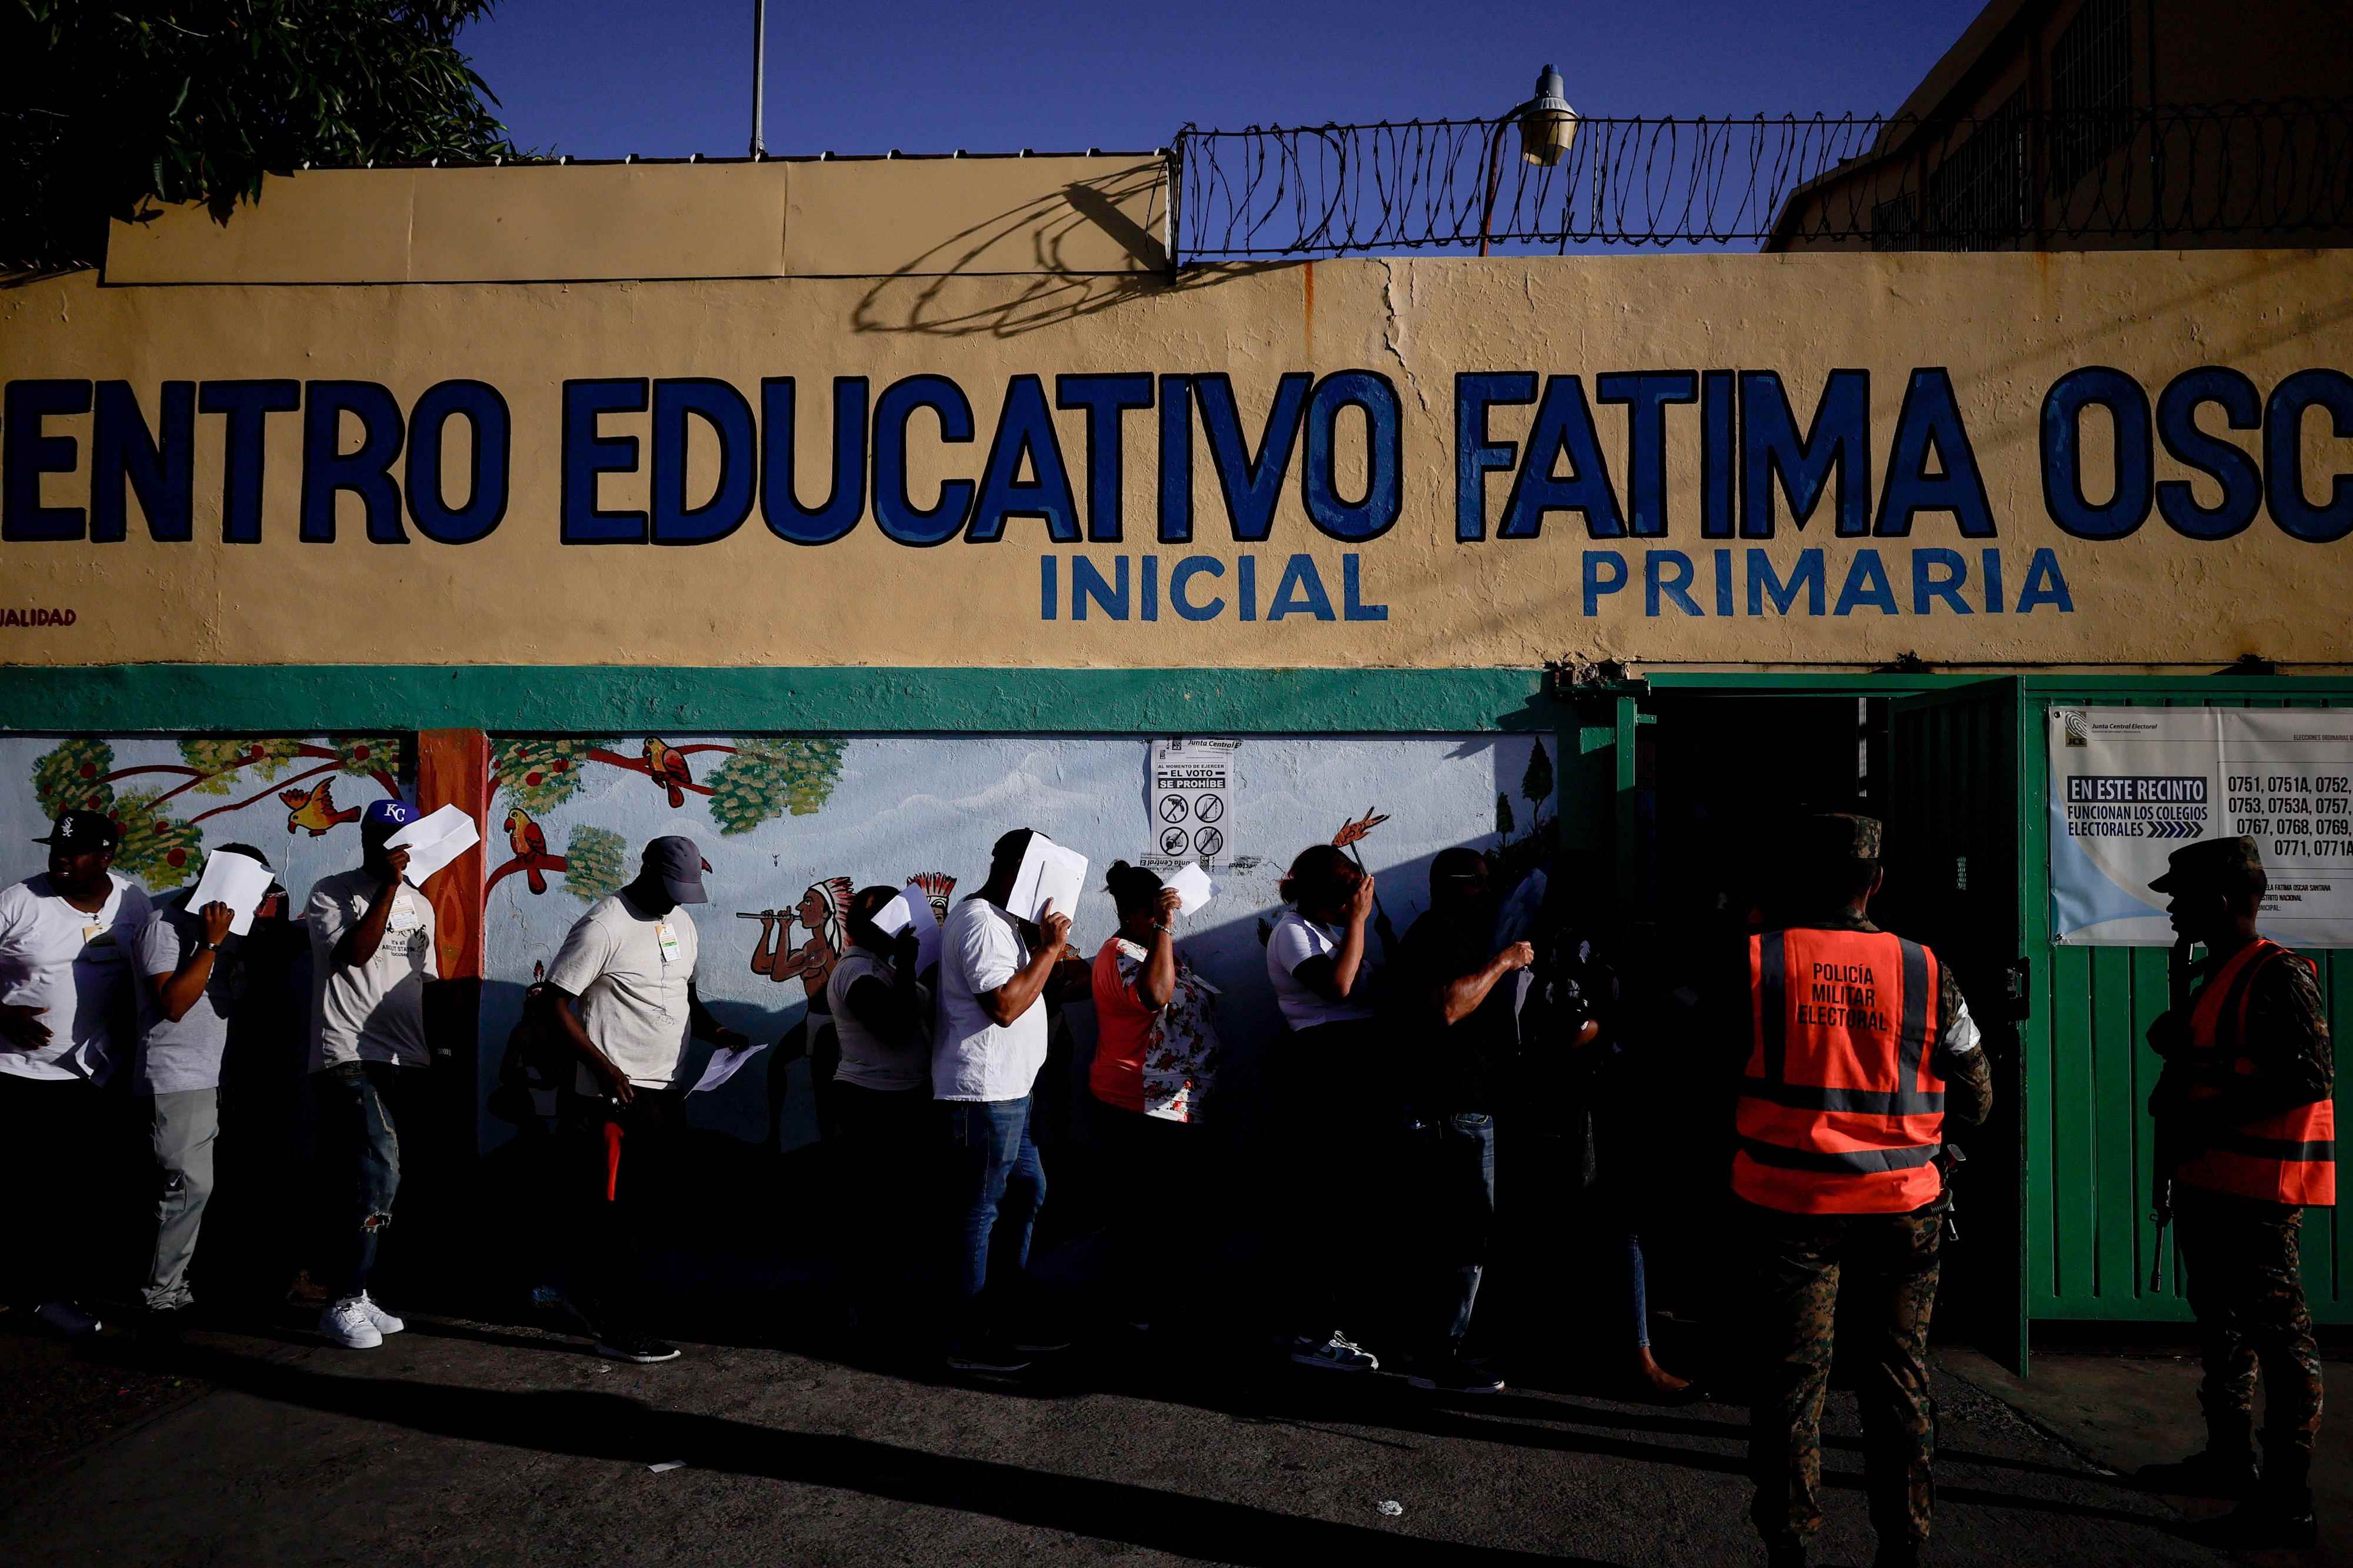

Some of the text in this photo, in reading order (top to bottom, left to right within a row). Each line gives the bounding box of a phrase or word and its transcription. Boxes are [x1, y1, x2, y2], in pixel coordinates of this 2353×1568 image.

[560, 369, 1402, 548] EDUCATIVO
[1454, 366, 1998, 543] FATIMA
[2039, 365, 2353, 543] OSC
[1041, 553, 1388, 622] INICIAL
[1583, 548, 2074, 616] PRIMARIA
[1159, 778, 1224, 788] SE PROHÍBE
[2071, 779, 2204, 800] EN ESTE RECINTO
[2228, 776, 2351, 795] 0751, 0751A, 0752,
[384, 803, 406, 822] KC
[2068, 806, 2208, 820] FUNCIONAN LOS COLEGIOS
[2229, 798, 2352, 816] 0753, 0753A, 0757,
[2068, 822, 2143, 836] ELECTORALES
[2237, 819, 2352, 836] 0767, 0768, 0769,
[2275, 840, 2311, 858] 0771,
[1813, 963, 1874, 985] POLICÍA
[1812, 983, 1875, 1007] MILITAR
[1798, 1005, 1887, 1031] ELECTORAL
